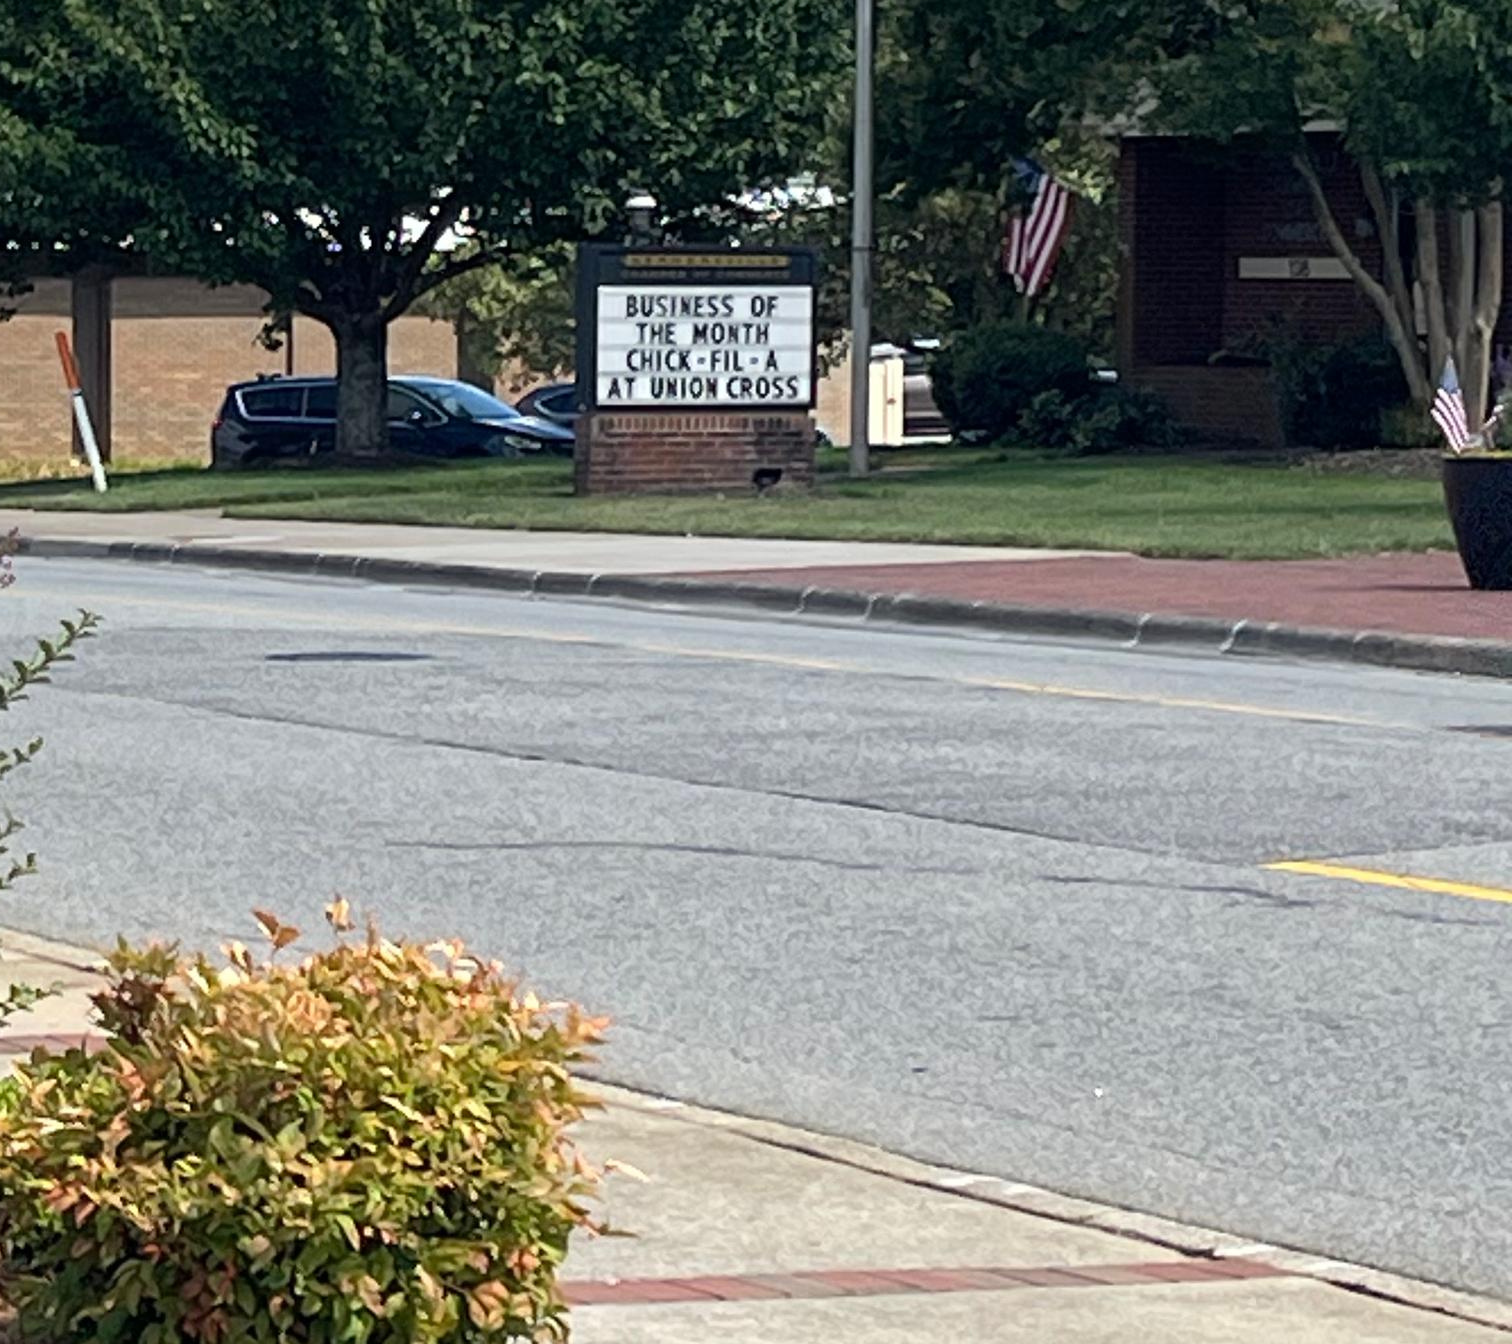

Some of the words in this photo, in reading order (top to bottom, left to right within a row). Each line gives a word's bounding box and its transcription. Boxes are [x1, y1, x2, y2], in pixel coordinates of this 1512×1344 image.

[625, 294, 734, 319] BUSINESS
[750, 295, 779, 318] OF
[636, 322, 676, 345] THE
[691, 322, 770, 345] MONTH
[626, 349, 779, 373] CHICK-FIL-A
[607, 377, 636, 400] AT
[650, 376, 718, 400] UNION
[726, 375, 799, 400] CROSS
